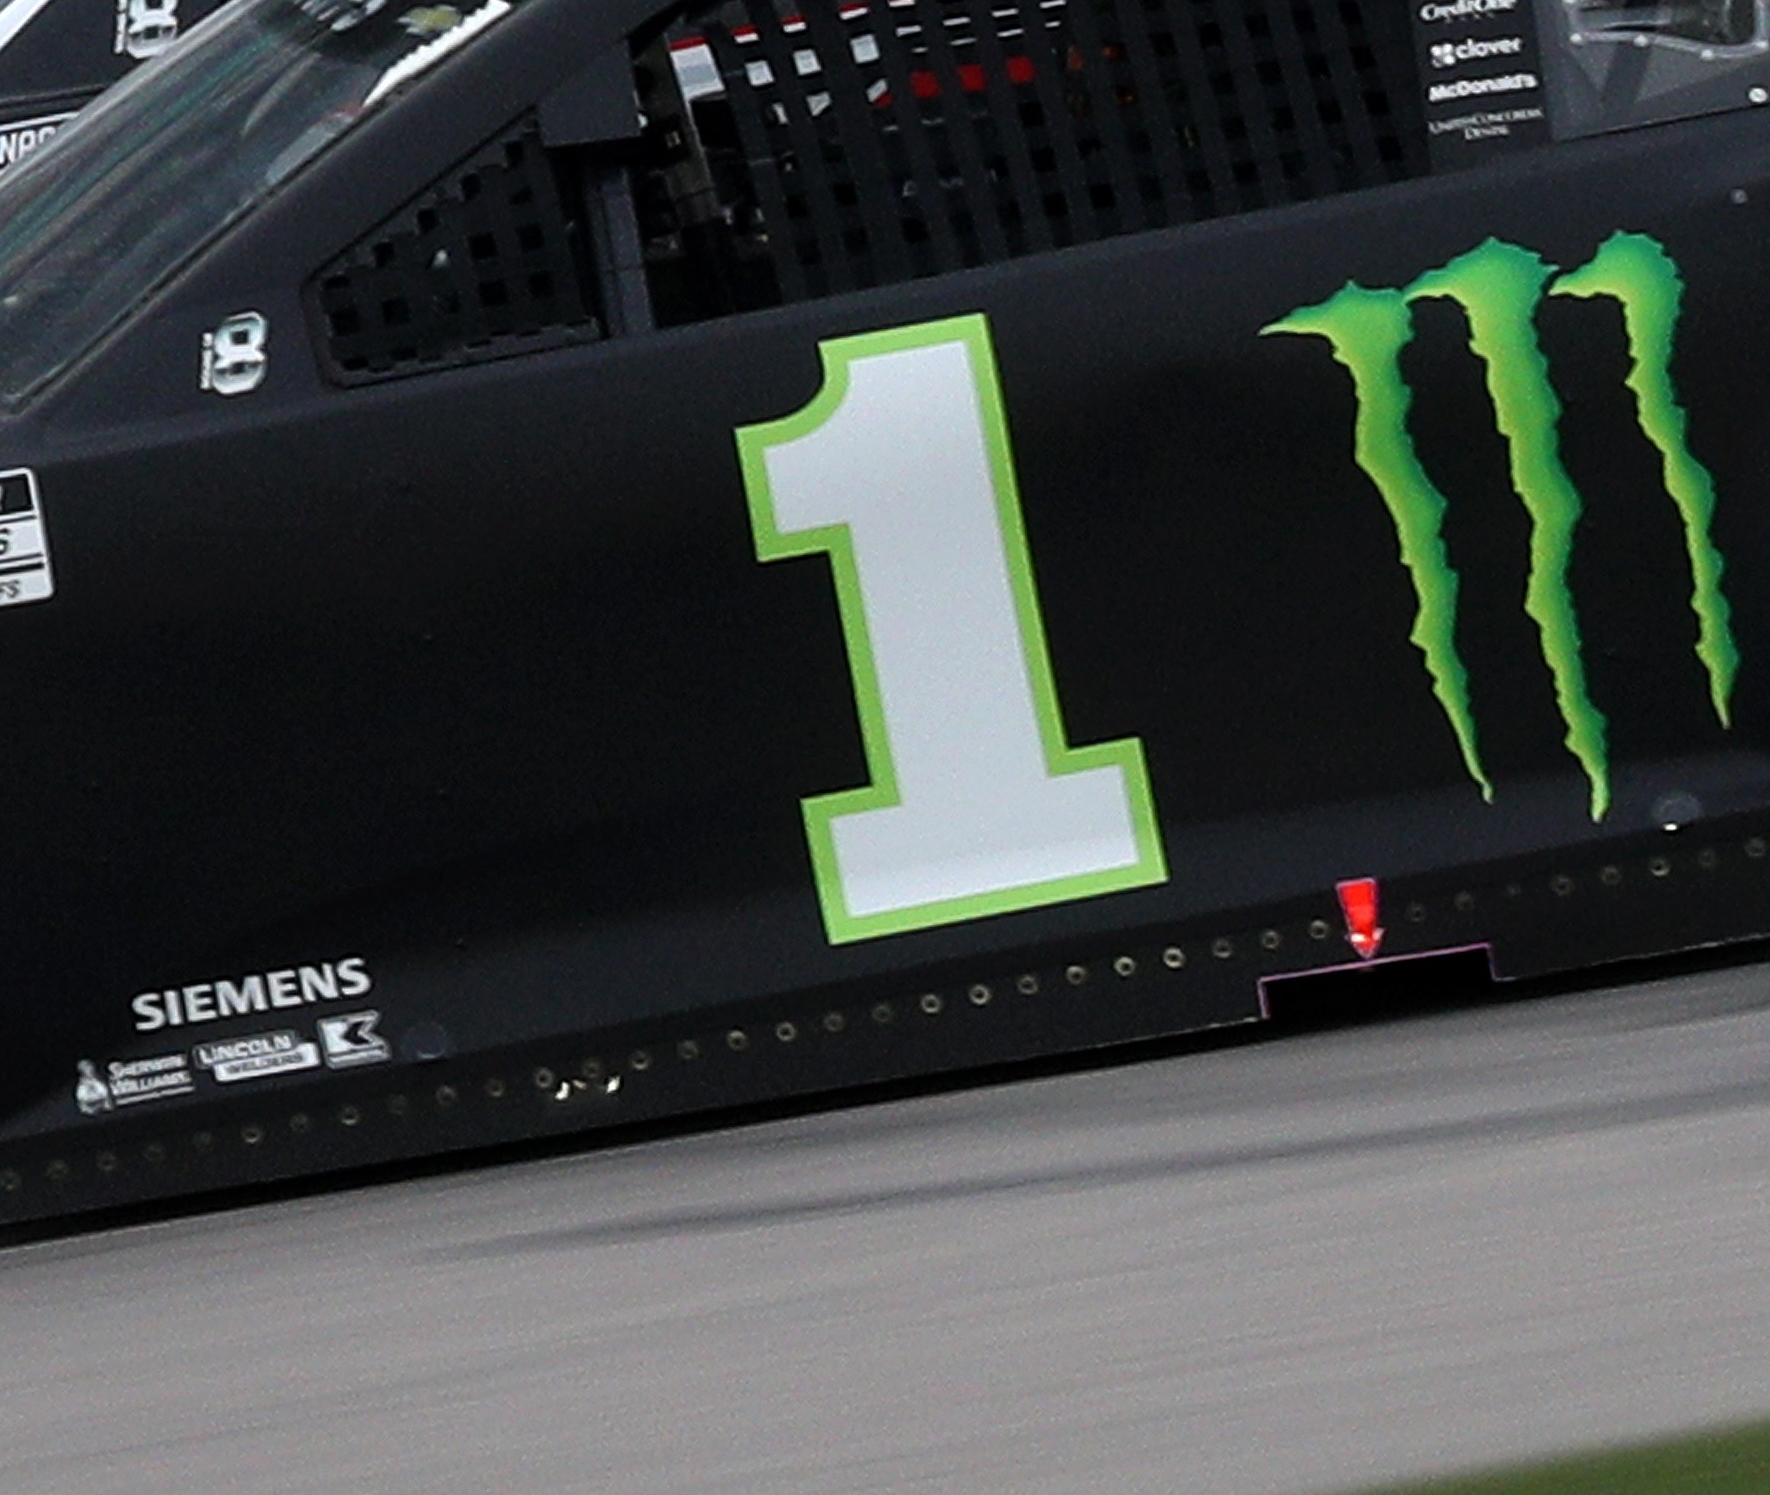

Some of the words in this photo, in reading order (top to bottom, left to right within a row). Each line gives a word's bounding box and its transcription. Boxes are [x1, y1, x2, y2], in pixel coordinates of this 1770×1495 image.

[1455, 38, 1521, 59] clover
[736, 312, 1167, 946] 1
[131, 957, 370, 1030] SIEMENS
[198, 1035, 292, 1061] LINCOLN
